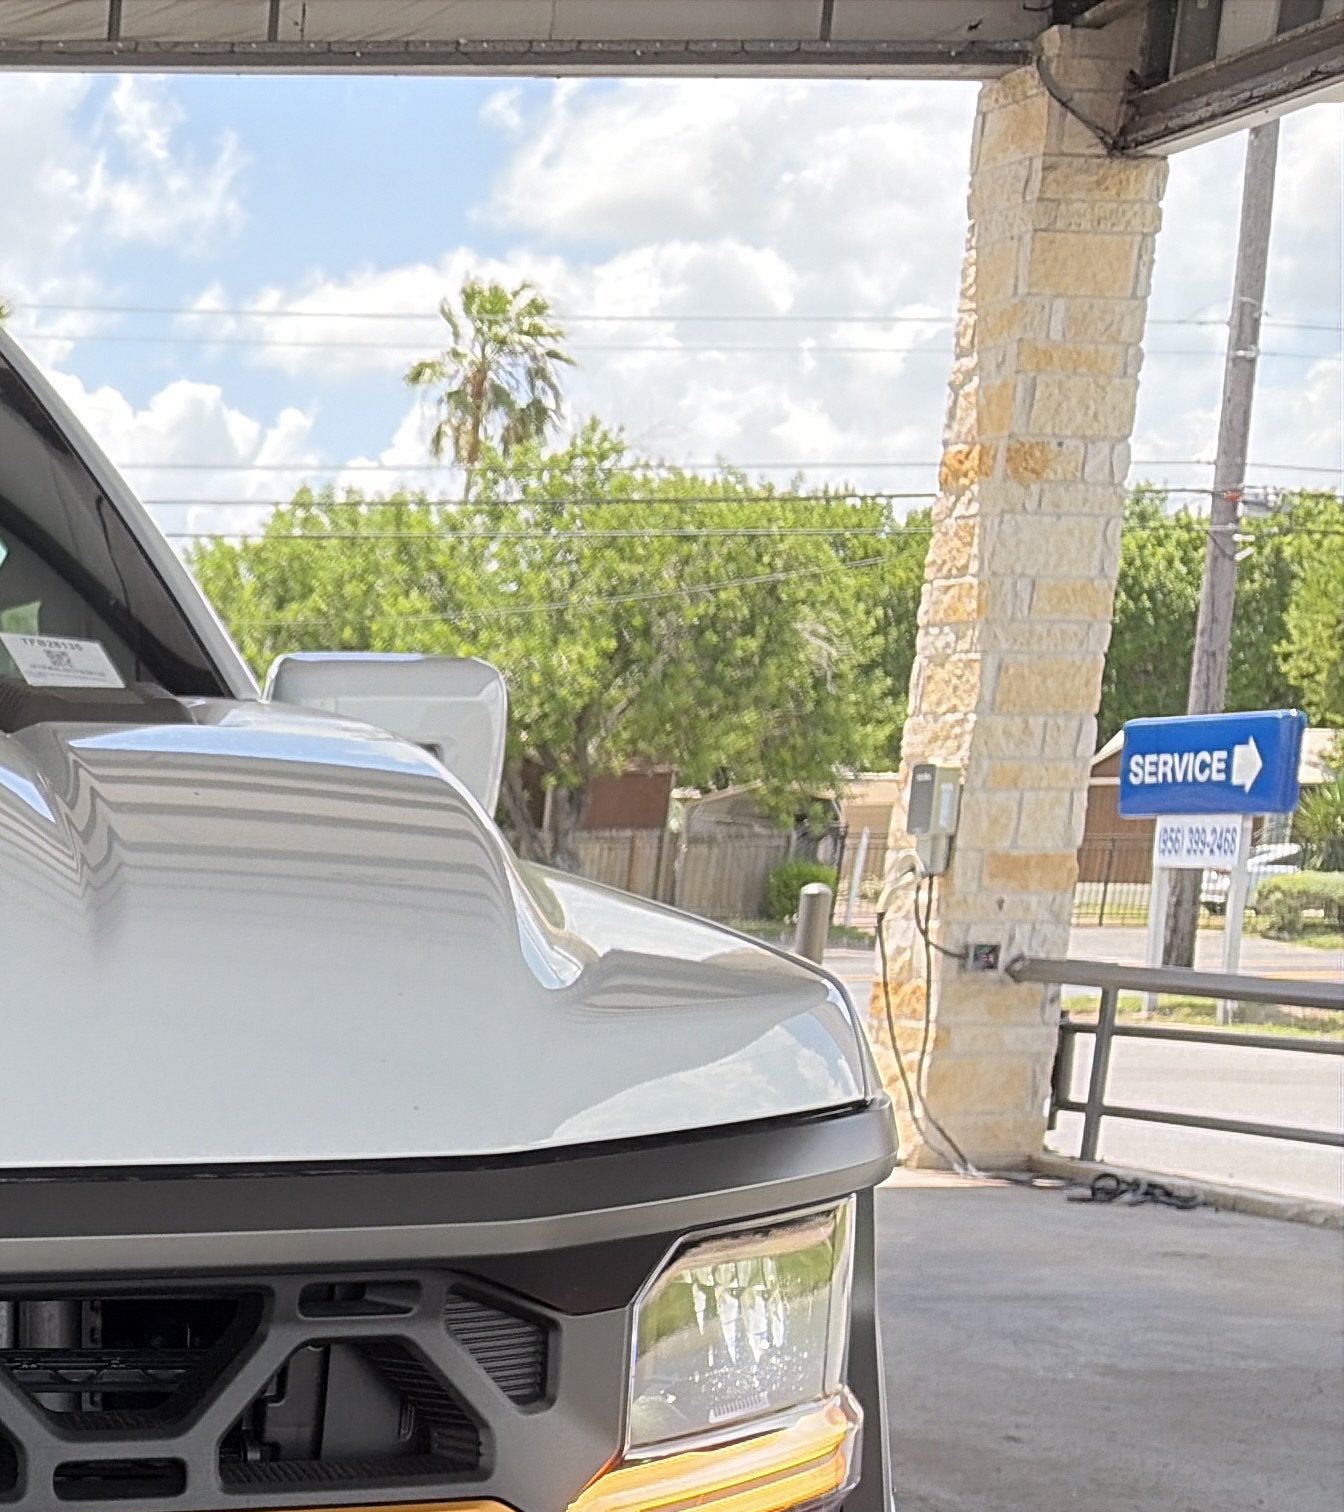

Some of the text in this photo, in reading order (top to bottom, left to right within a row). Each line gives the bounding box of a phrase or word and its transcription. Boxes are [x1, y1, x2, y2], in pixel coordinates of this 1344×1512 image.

[1129, 750, 1228, 785] SERVICE
[1159, 826, 1237, 856] (956) 399-2468
